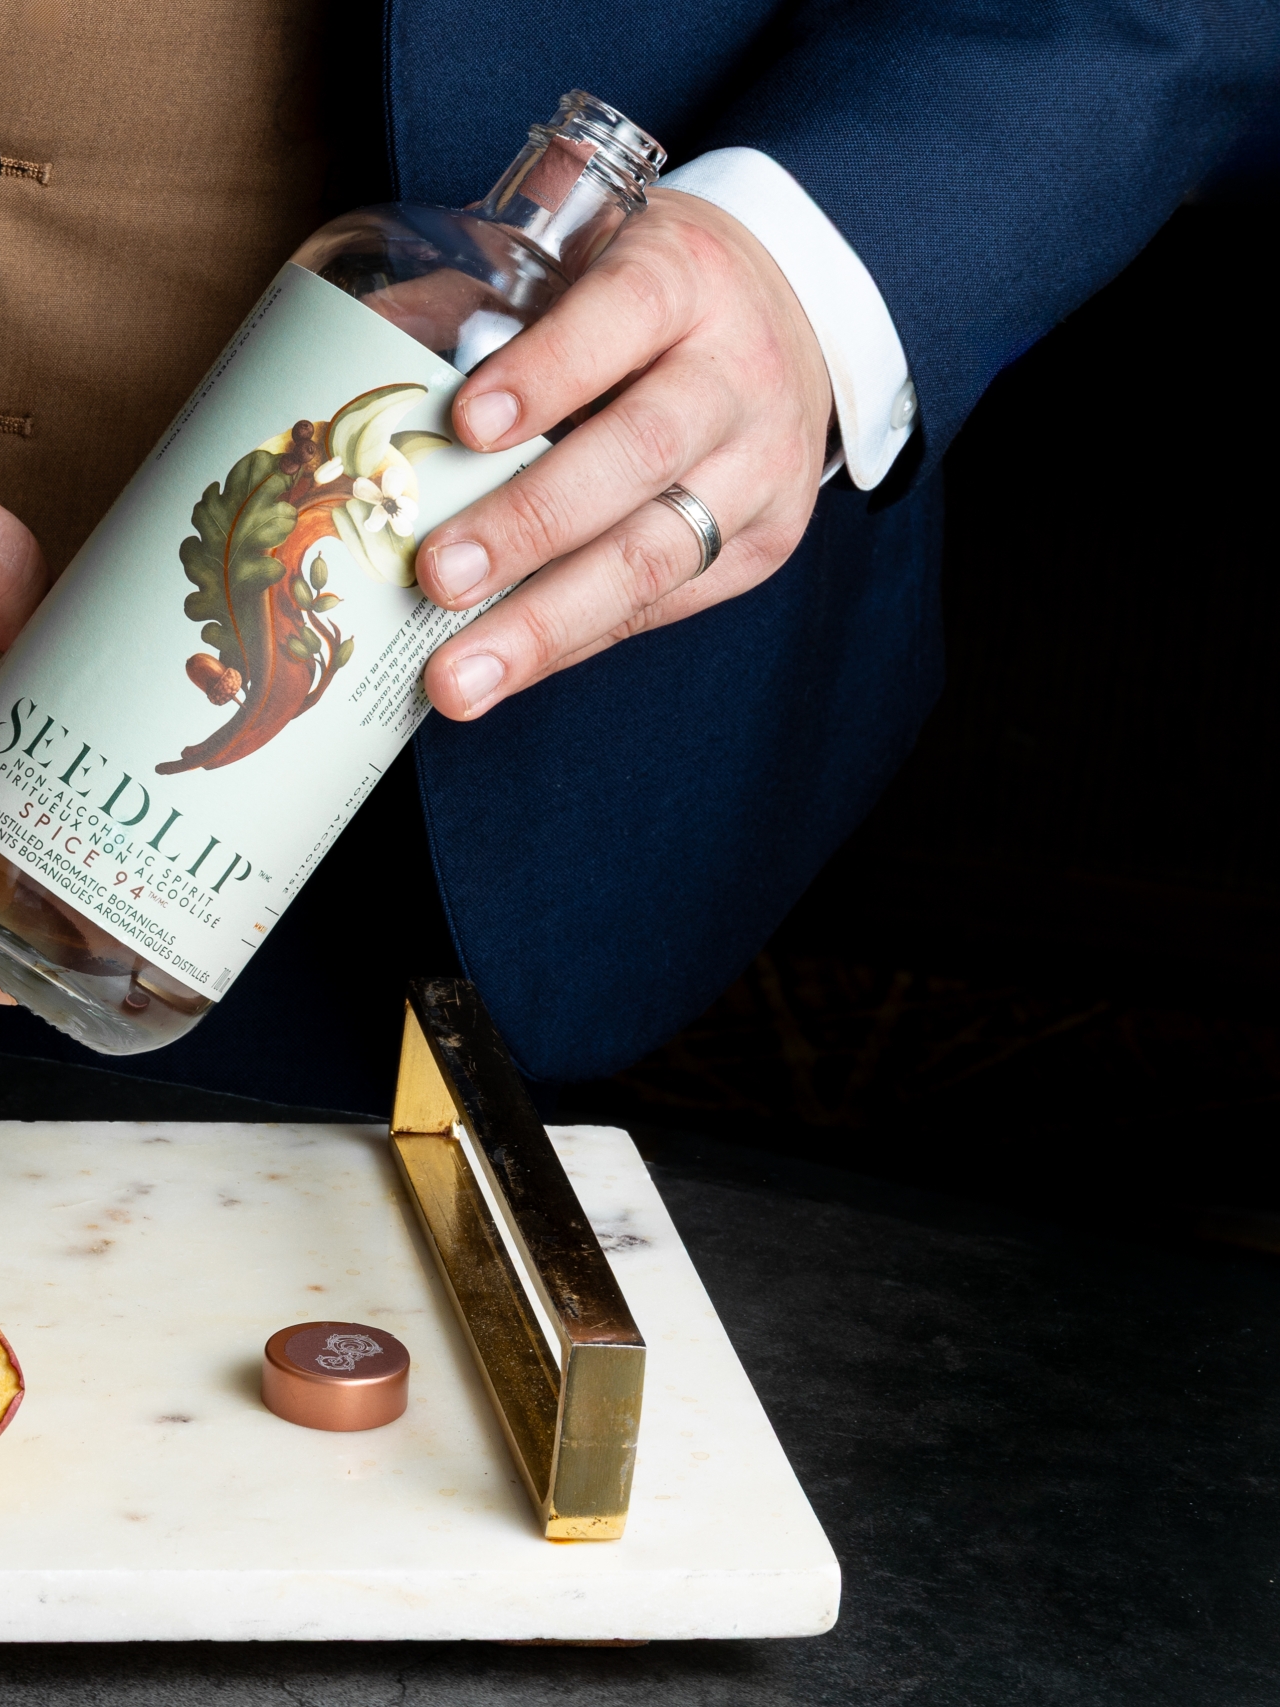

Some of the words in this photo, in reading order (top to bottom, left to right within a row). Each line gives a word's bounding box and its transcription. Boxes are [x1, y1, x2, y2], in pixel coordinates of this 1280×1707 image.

[257, 287, 282, 320] SERVE
[238, 331, 250, 347] OZ
[216, 349, 238, 378] OVER
[200, 380, 215, 399] ICE
[155, 427, 182, 461] TONIC
[415, 602, 439, 632] ecettes
[378, 626, 407, 663] Londres
[397, 631, 417, 657] tirées
[424, 626, 434, 639] de
[424, 617, 452, 654] agrumes
[387, 656, 399, 670] du
[406, 638, 426, 663] chêne
[417, 655, 426, 665] se
[369, 662, 379, 675] en
[372, 670, 390, 691] livre
[391, 673, 401, 685] de
[392, 665, 420, 700] côtoient
[347, 675, 371, 703] 1651.
[358, 684, 392, 728] cascarille.
[376, 698, 393, 721] pour
[345, 776, 370, 807] NON
[13, 757, 156, 867] NON-ALCOHOLIC
[162, 868, 214, 908] SPIRIT
[18, 801, 101, 868] SPICE
[112, 870, 145, 900] 94
[89, 832, 128, 865] NON
[134, 866, 222, 930] ALCOOLISÉ
[43, 848, 108, 898] AROMATIC
[107, 893, 177, 946] BOTANICALS
[18, 845, 95, 906] BOTANIQUES
[93, 902, 173, 960] AROMATIQUES
[171, 955, 211, 985] DISTILLÉS
